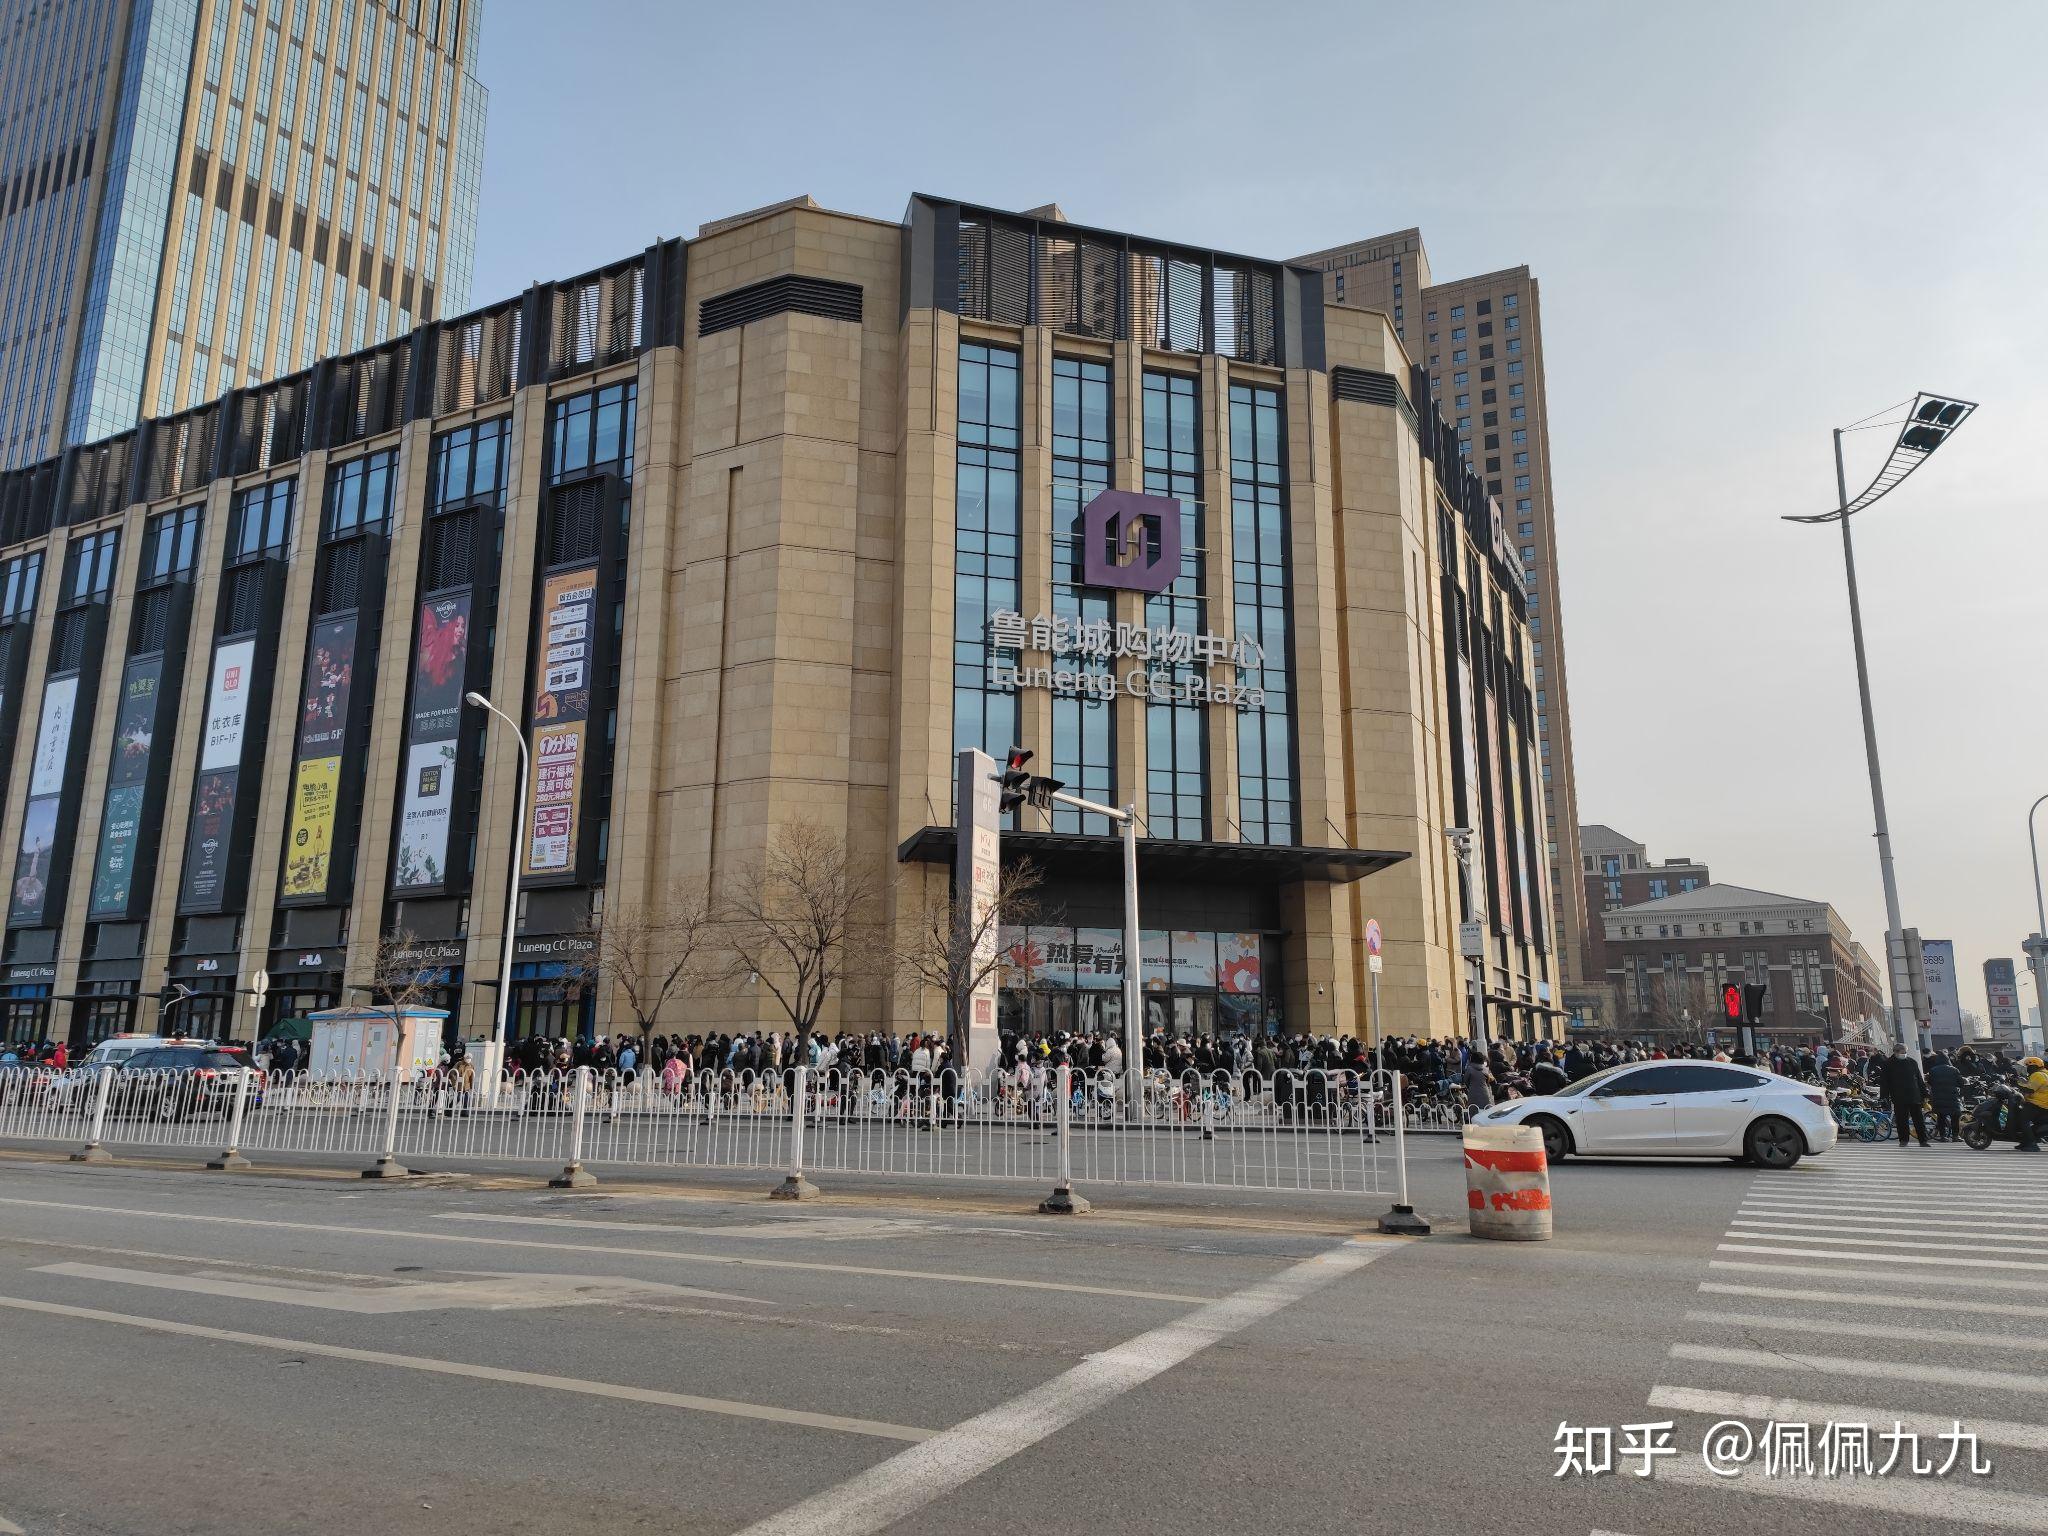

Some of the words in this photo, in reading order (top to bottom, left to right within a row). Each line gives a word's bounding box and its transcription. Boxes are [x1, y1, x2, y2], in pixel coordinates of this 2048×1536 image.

[989, 608, 1267, 669] 鲁能城购物中心
[226, 669, 239, 680] UNI
[992, 650, 1117, 701] Luneng
[1126, 669, 1172, 699] CC
[1184, 674, 1266, 706] Plaza
[224, 678, 238, 690] QLO
[415, 711, 431, 720] MADE
[431, 709, 442, 718] FOR
[442, 707, 459, 715] MUSIC
[212, 714, 242, 731] 优衣库
[210, 732, 238, 747] B1F-1F
[331, 729, 343, 740] 5F
[538, 763, 575, 781] 建行福利
[536, 777, 574, 794] 最高可领
[113, 890, 125, 902] 4F
[393, 949, 423, 960] Luneng
[424, 947, 437, 958] CC
[437, 945, 460, 957] Plaza
[518, 941, 551, 954] Luneng
[552, 940, 567, 951] CC
[568, 938, 593, 949] Plaza
[197, 959, 219, 971] FILA
[299, 952, 322, 966] FILA
[10, 969, 31, 979] Luneng
[30, 968, 40, 977] CC
[39, 967, 56, 977] Plaza
